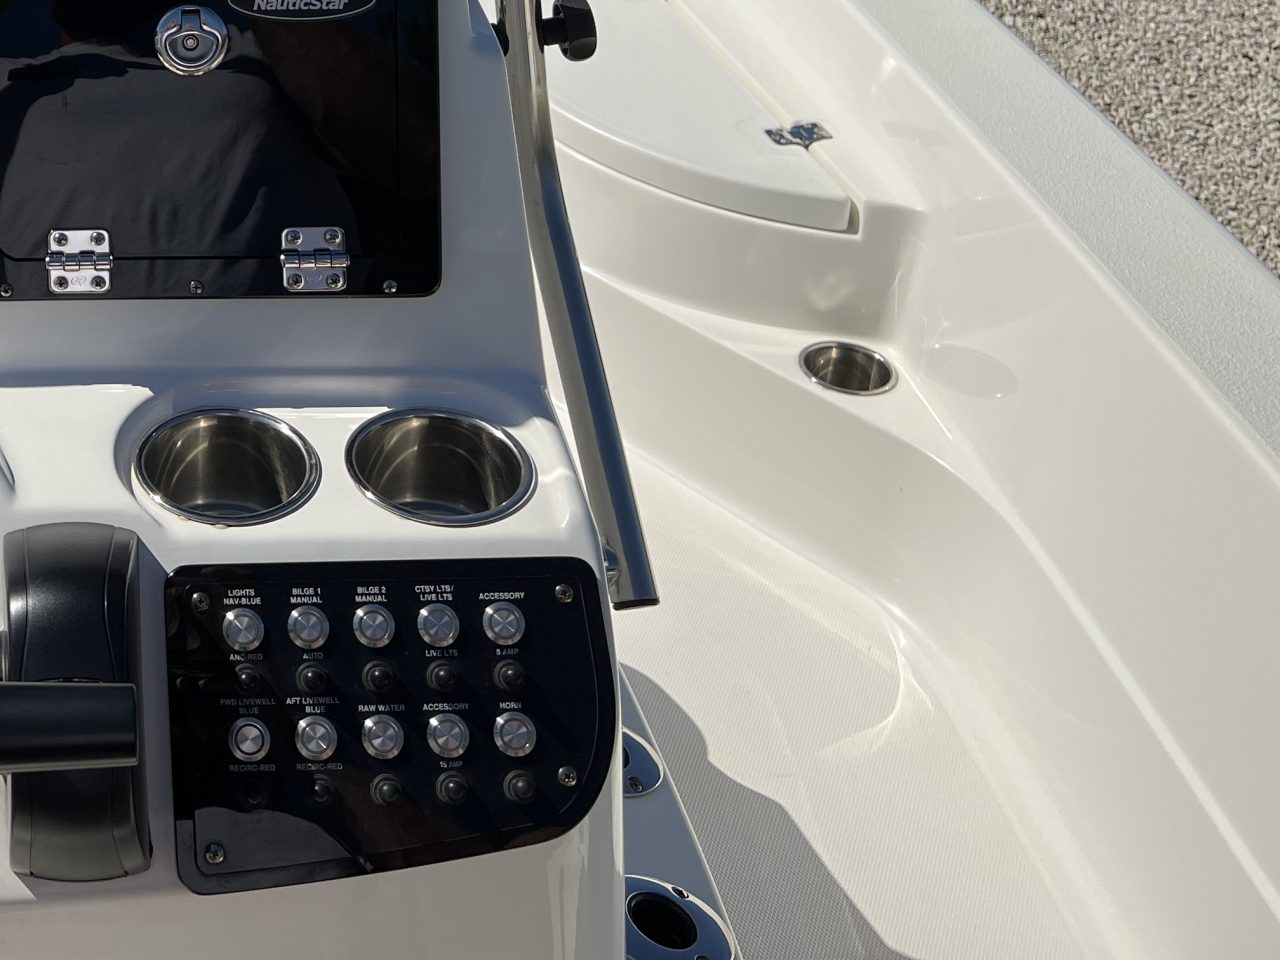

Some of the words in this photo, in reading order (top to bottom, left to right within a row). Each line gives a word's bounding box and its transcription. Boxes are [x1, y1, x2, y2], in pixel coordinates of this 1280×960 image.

[228, 589, 255, 597] LIGHTS
[292, 588, 314, 596] BILGE
[356, 586, 379, 594] BILGE
[380, 586, 387, 594] 2
[414, 585, 435, 593] CTSY
[436, 585, 454, 593] LTS/
[290, 596, 323, 604] MANUAL
[355, 594, 388, 602] MANUAL
[420, 593, 438, 601] LIVE
[438, 593, 453, 601] LTS
[479, 592, 525, 600] ACCESSORY
[223, 597, 262, 605] NAV-BLUE
[302, 652, 323, 660] AUTO
[425, 649, 442, 657] LIVE
[443, 649, 458, 657] LTS
[502, 648, 520, 656] AMP
[220, 698, 238, 706] FWD
[239, 697, 276, 706] LIVEWELL
[302, 696, 340, 705] LIVEWELL
[377, 704, 405, 712] WATER
[422, 703, 470, 711] ACCESSORY
[500, 701, 522, 709] HORN
[239, 706, 260, 714] BLUE
[448, 760, 463, 768] AMP
